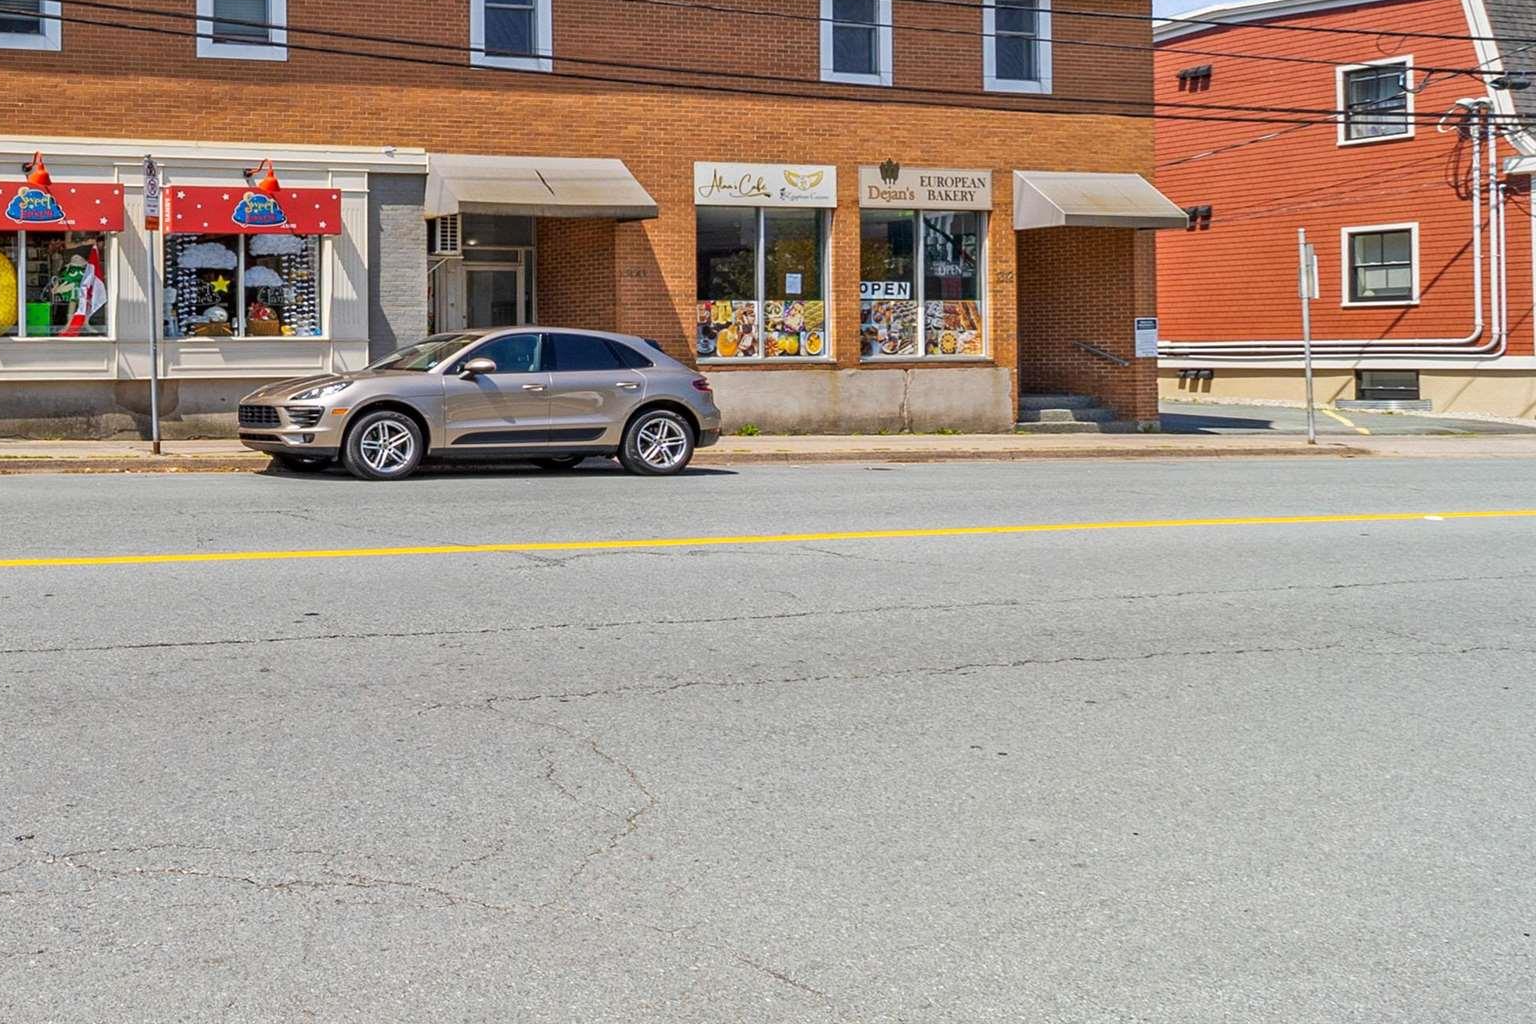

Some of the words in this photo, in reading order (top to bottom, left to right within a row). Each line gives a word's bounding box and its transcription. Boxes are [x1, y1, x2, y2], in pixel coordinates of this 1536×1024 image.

[920, 176, 986, 188] EUROPEAN
[18, 186, 52, 209] Sweet
[868, 185, 915, 202] Dejan's
[928, 189, 976, 202] BAKERY
[860, 282, 908, 296] OPEN
